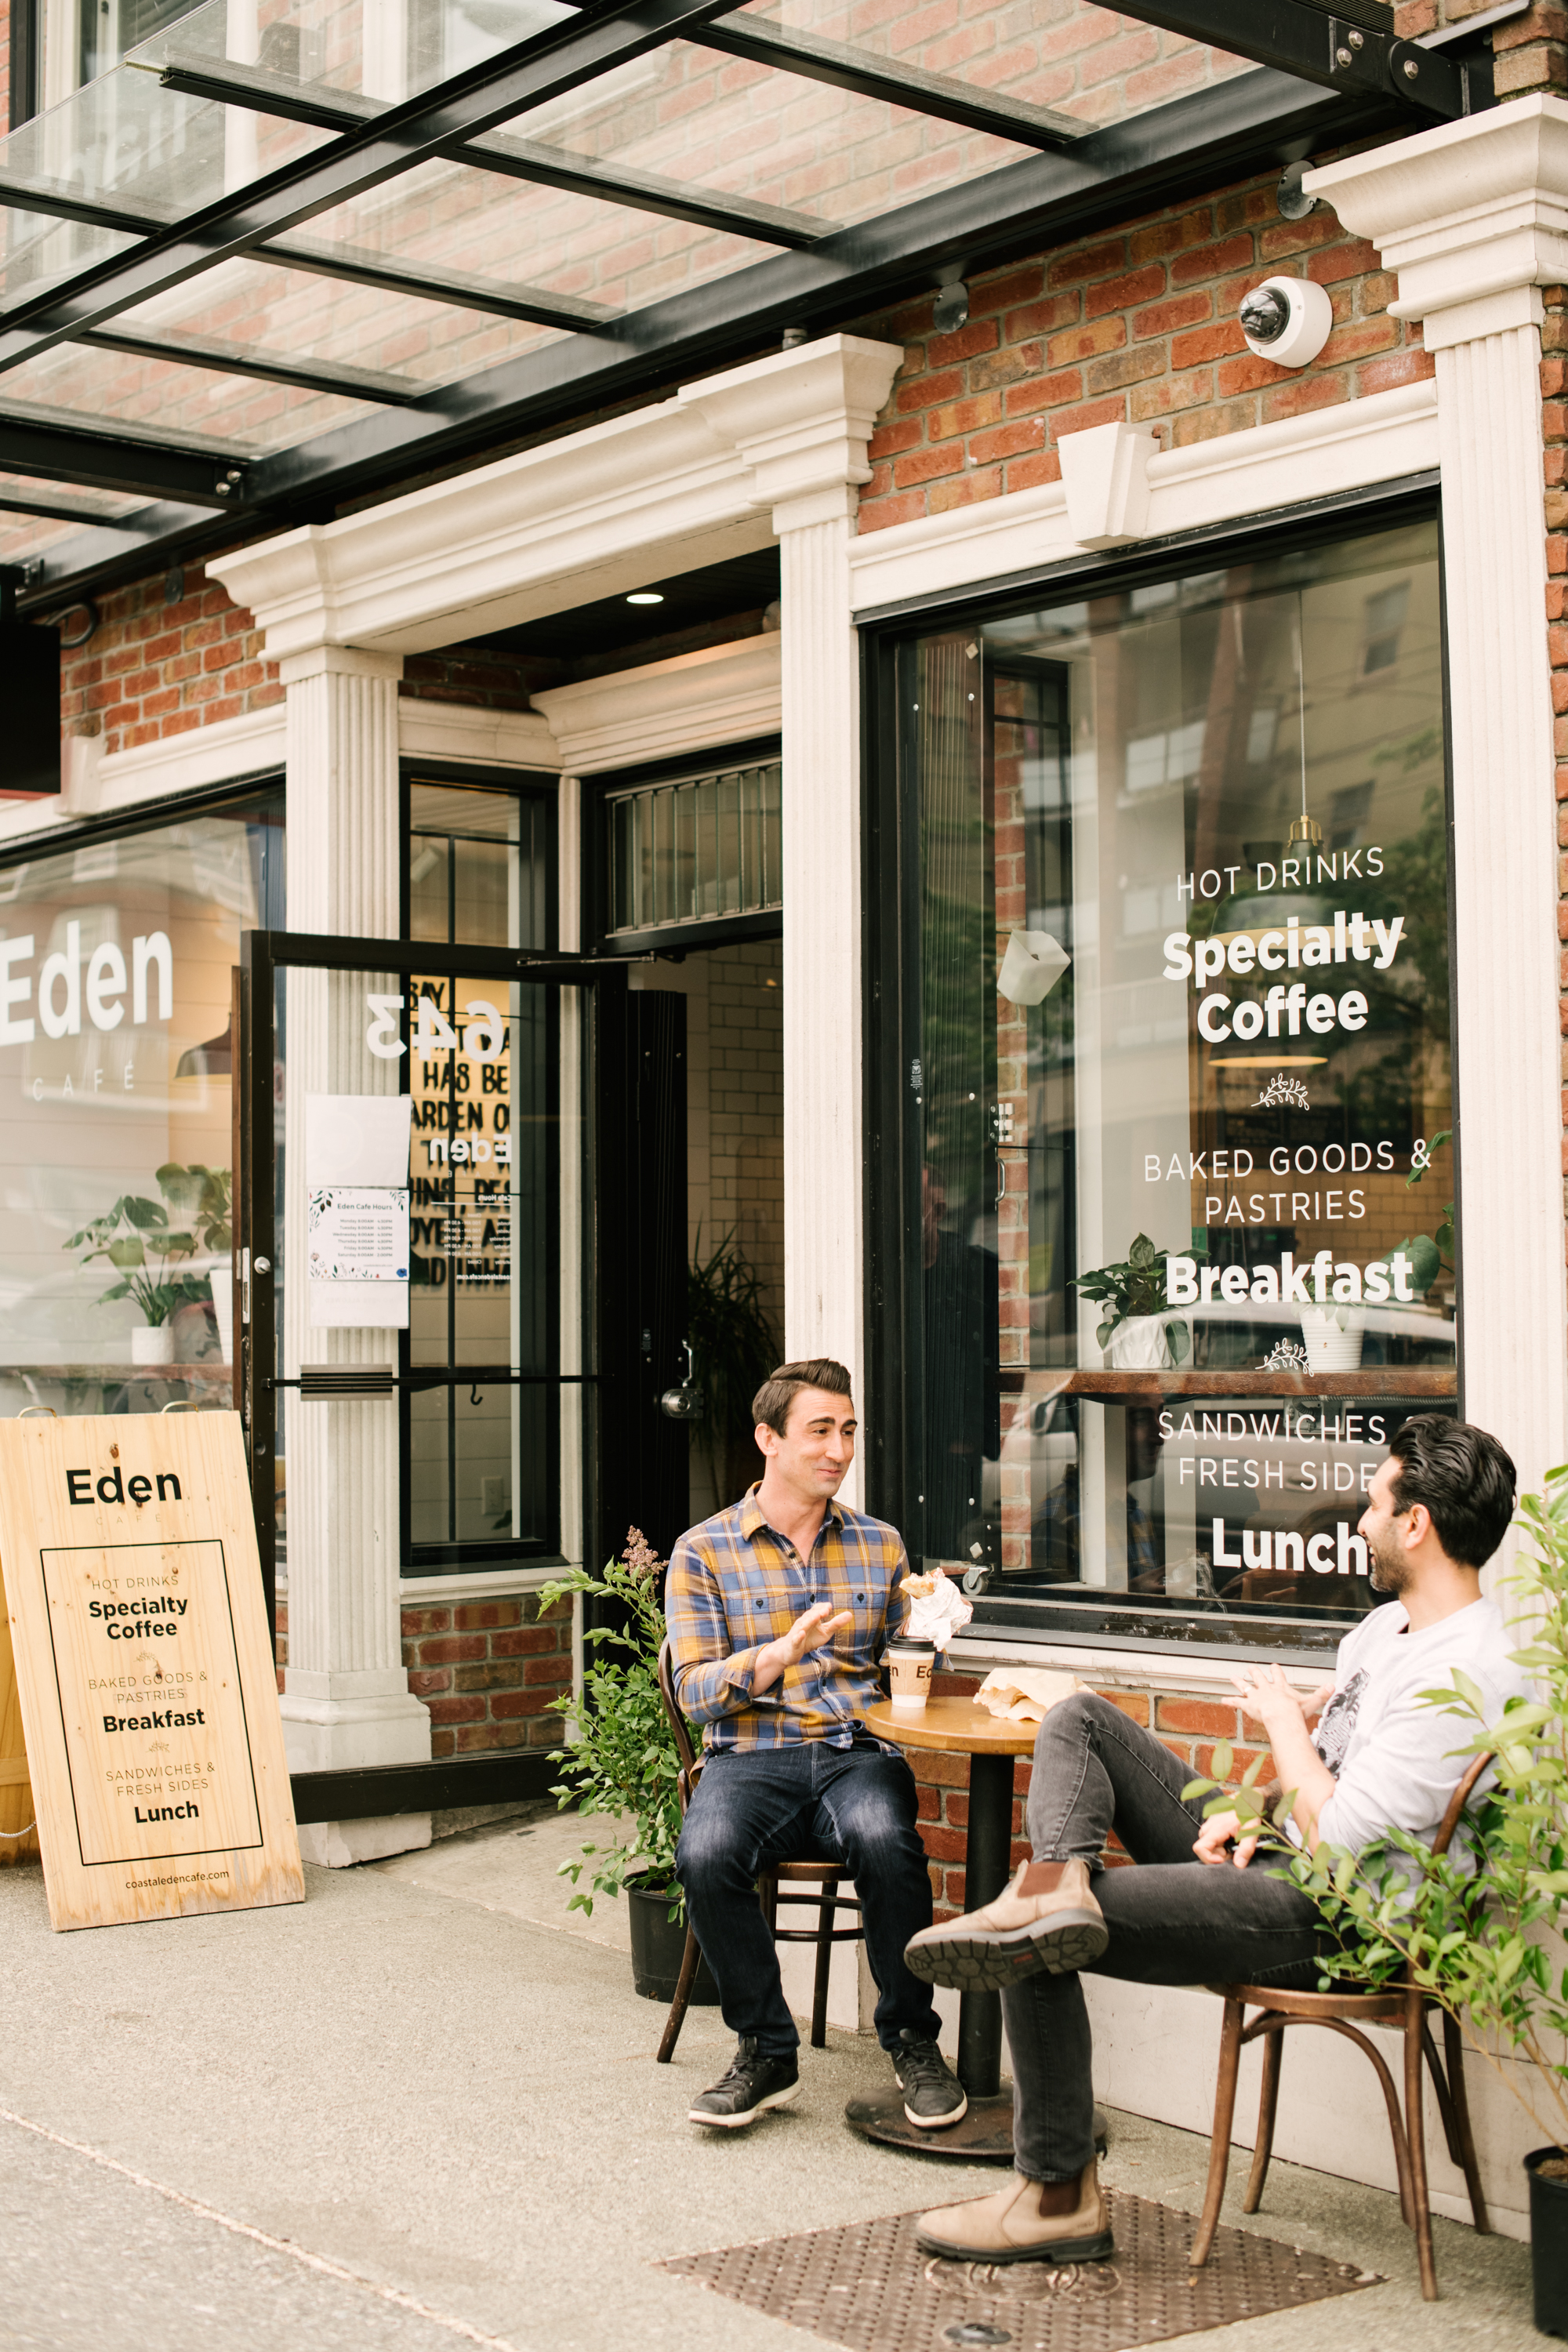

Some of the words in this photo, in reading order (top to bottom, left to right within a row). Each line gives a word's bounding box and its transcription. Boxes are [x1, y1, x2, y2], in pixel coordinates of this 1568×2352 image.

[1177, 866, 1241, 901] HOT
[1257, 846, 1385, 891] DRINKS
[1162, 910, 1405, 989] Specialty
[0, 920, 172, 1047] Eden
[1197, 982, 1369, 1044] Coffee
[33, 1061, 134, 1102] CAFÉ
[412, 1100, 484, 1134] ARDEN
[1145, 1149, 1254, 1182] BAKED
[1269, 1140, 1395, 1176] GOODS
[1410, 1138, 1432, 1169] &
[1206, 1189, 1367, 1225] PASTRIES
[1166, 1250, 1414, 1305] Breakfast
[1158, 1411, 1386, 1445] SANDWICHES
[66, 1466, 183, 1505] Eden
[1179, 1457, 1284, 1489] FRESH
[1300, 1461, 1377, 1492] SIDE
[1212, 1518, 1368, 1576] Lunch
[92, 1579, 119, 1590] HOT
[126, 1575, 179, 1588] DRINKS
[89, 1596, 188, 1621] Specialty
[107, 1620, 177, 1640] Coffee
[89, 1676, 136, 1690] BAKED
[143, 1671, 194, 1686] GOODS
[199, 1671, 208, 1681] &
[117, 1688, 185, 1704] PASTRIES
[103, 1708, 205, 1733] Breakfast
[106, 1762, 201, 1781] SANDWICHES
[207, 1762, 216, 1773] &
[117, 1783, 162, 1797] FRESH
[169, 1778, 209, 1792] SIDES
[134, 1801, 199, 1824] Lunch
[125, 1871, 230, 1889] coastaledencafe.com
